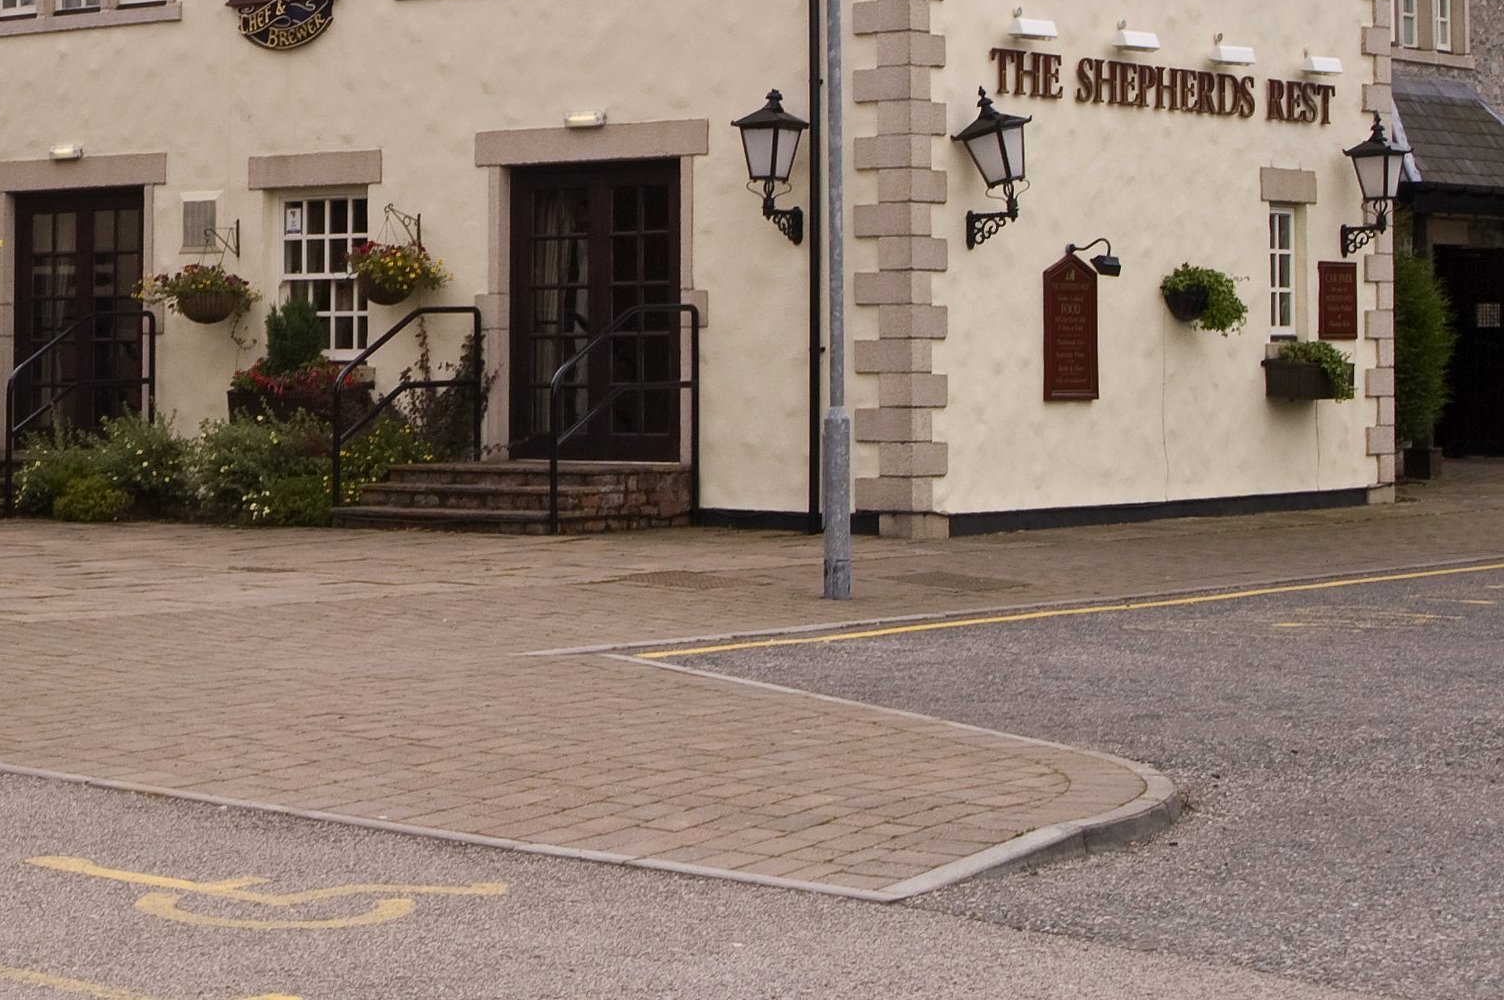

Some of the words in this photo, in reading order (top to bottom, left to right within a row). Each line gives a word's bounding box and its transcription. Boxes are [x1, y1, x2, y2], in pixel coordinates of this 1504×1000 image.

[238, 5, 272, 35] CHEF
[275, 0, 286, 15] &
[267, 13, 325, 48] BREWER
[989, 47, 1064, 99] THE
[1075, 57, 1256, 118] SHEPHERDS
[1266, 78, 1336, 125] REST
